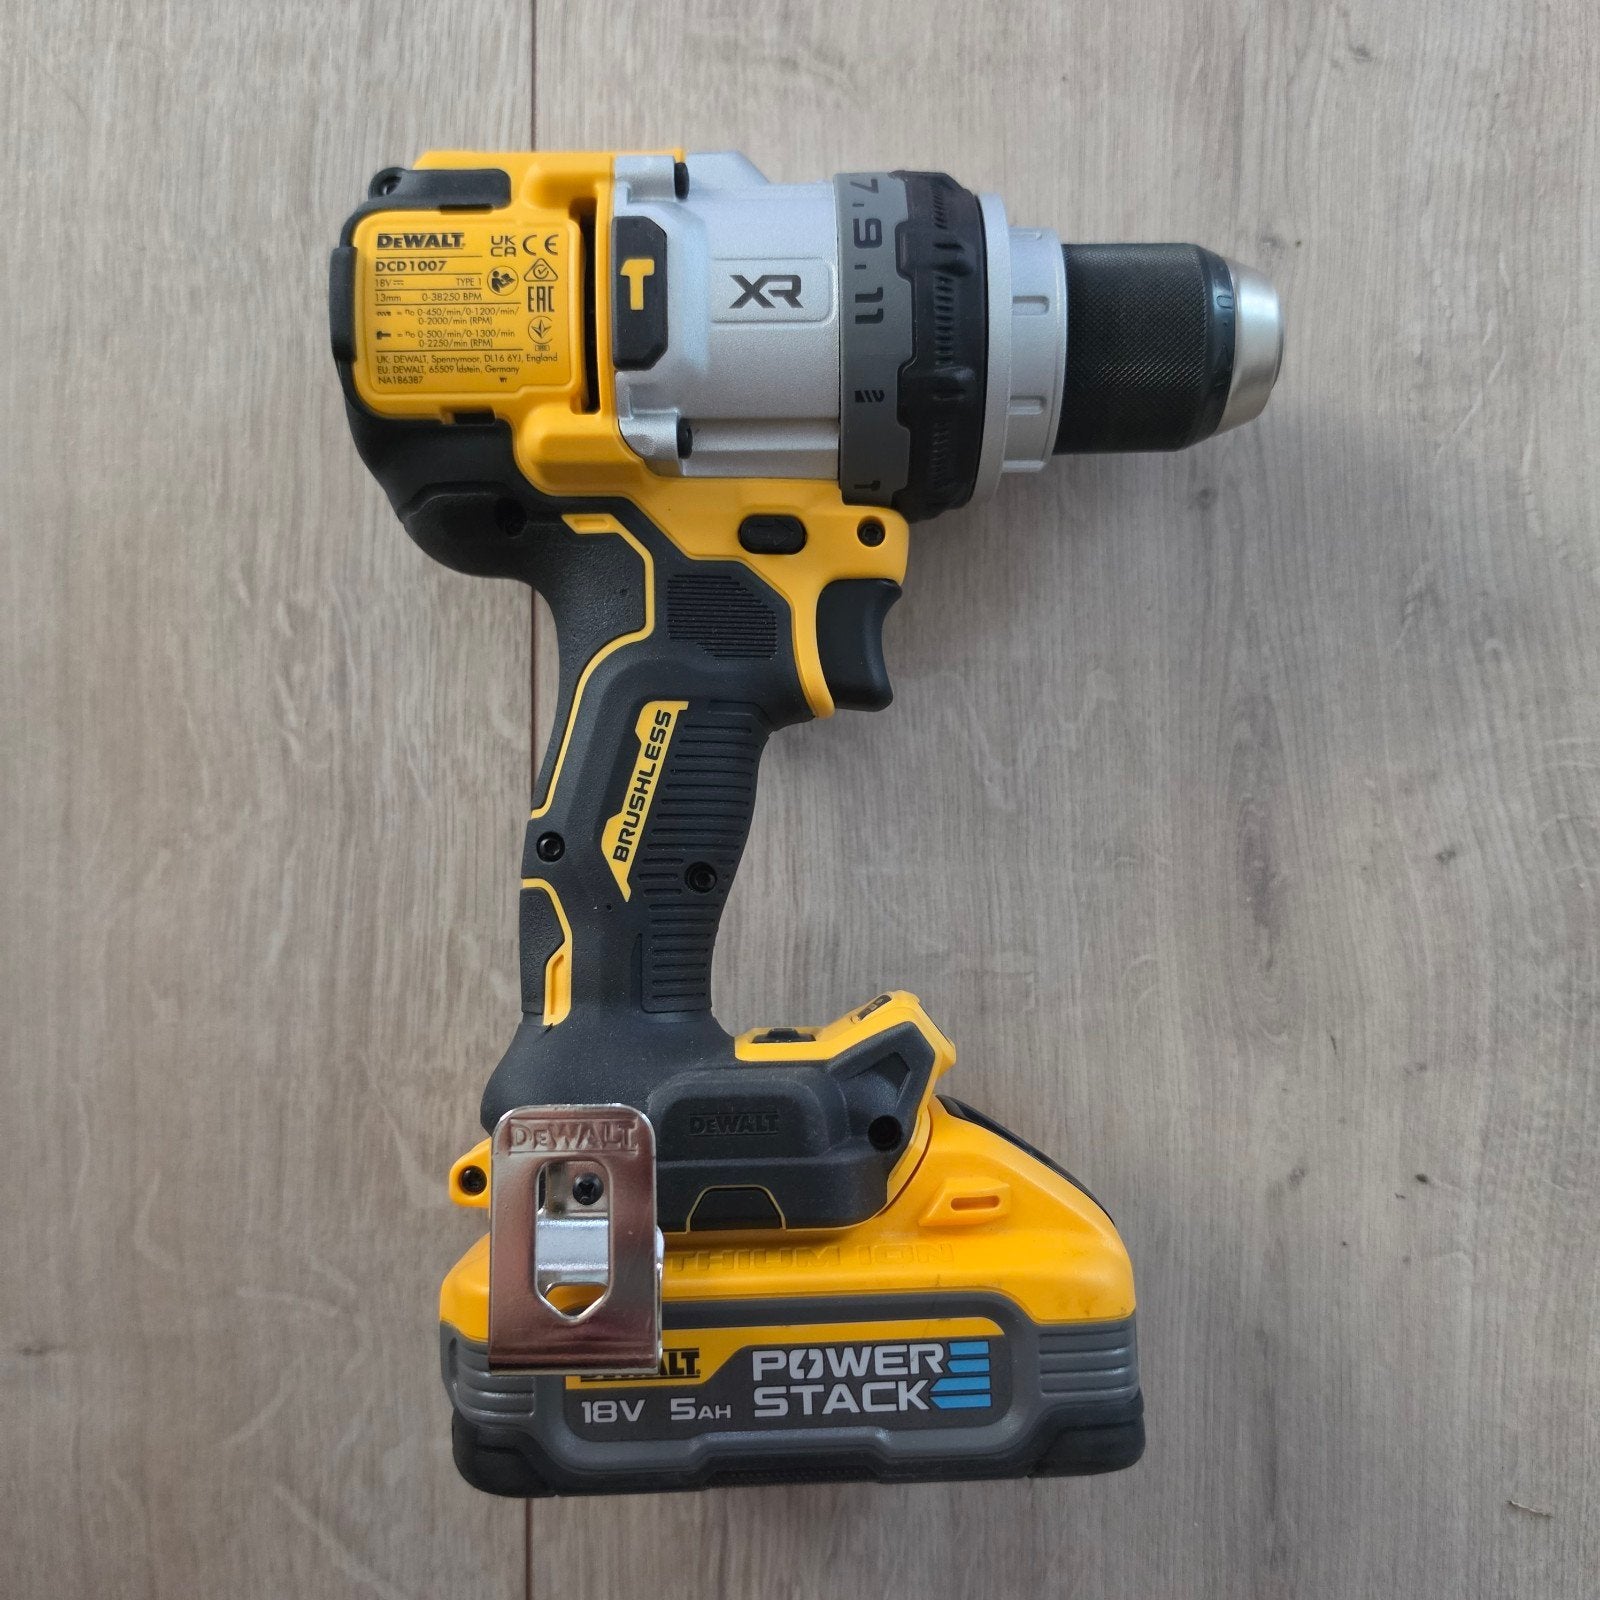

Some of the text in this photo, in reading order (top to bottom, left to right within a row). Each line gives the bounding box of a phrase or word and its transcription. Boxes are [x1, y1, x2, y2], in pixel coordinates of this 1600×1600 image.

[377, 233, 464, 249] DEWALT
[490, 235, 516, 246] UK
[853, 218, 883, 249] 9
[490, 246, 517, 257] CA
[522, 234, 559, 256] CE
[375, 260, 447, 272] DCD1007
[456, 277, 475, 286] TYPE
[375, 293, 402, 302] 13mm
[421, 292, 482, 301] 0-38250 BPM
[527, 286, 555, 312] EAC
[728, 274, 804, 309] XR
[854, 287, 884, 325] 11
[470, 316, 493, 326] (RPM)
[470, 338, 494, 349] (RPM)
[431, 354, 482, 367] Spennymoor,
[484, 354, 505, 363] DL16
[526, 352, 558, 364] England
[428, 365, 455, 374] 65509
[484, 364, 520, 375] Germany
[378, 376, 424, 385] NA186387
[612, 709, 672, 863] BRUSHLESS
[688, 1113, 779, 1136] DEWALT
[509, 1119, 639, 1156] DEWALT
[671, 1246, 840, 1274] THIUM
[752, 1342, 945, 1382] POWER
[753, 1379, 930, 1418] STACK
[581, 1399, 646, 1424] 18V
